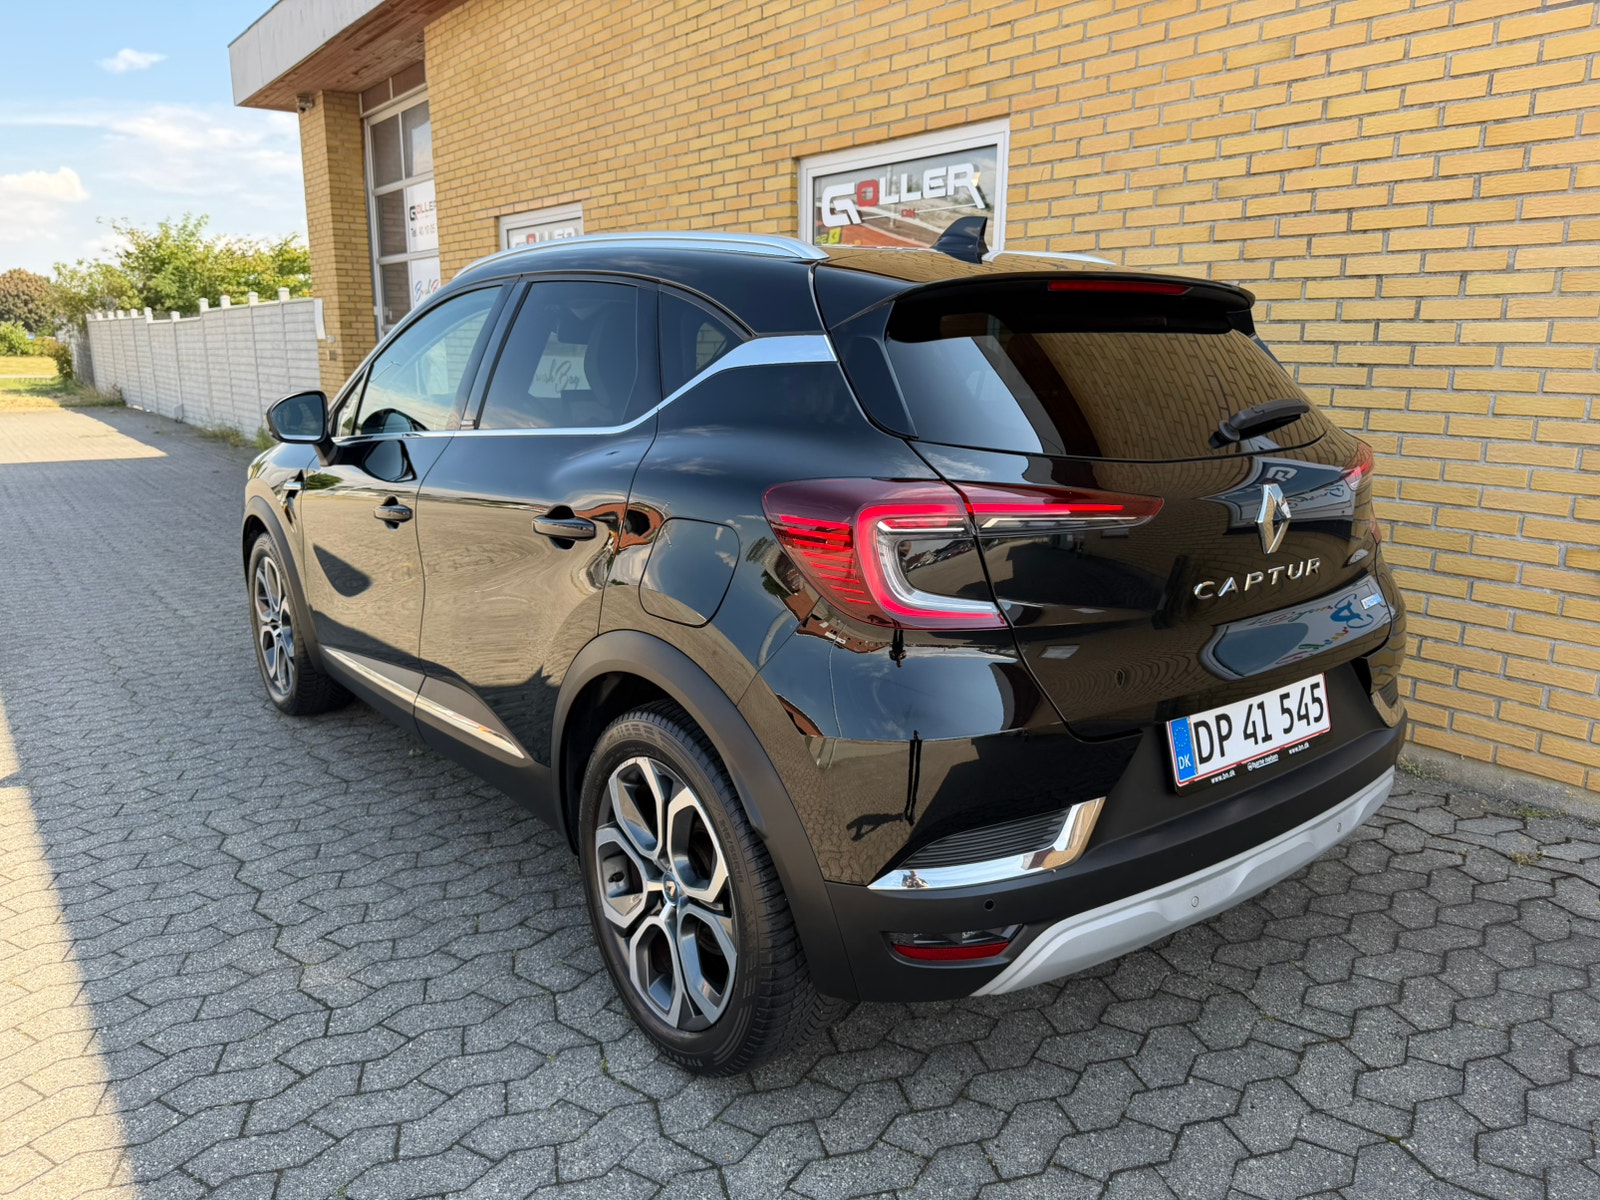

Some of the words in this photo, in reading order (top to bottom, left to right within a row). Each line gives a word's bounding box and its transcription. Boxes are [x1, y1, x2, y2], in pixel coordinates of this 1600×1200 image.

[821, 162, 986, 228] GOLLER
[1193, 557, 1321, 600] CAPTUR
[1193, 713, 1233, 765] DP
[1243, 700, 1273, 746] 41
[1279, 682, 1324, 735] 545
[1178, 753, 1192, 770] DK
